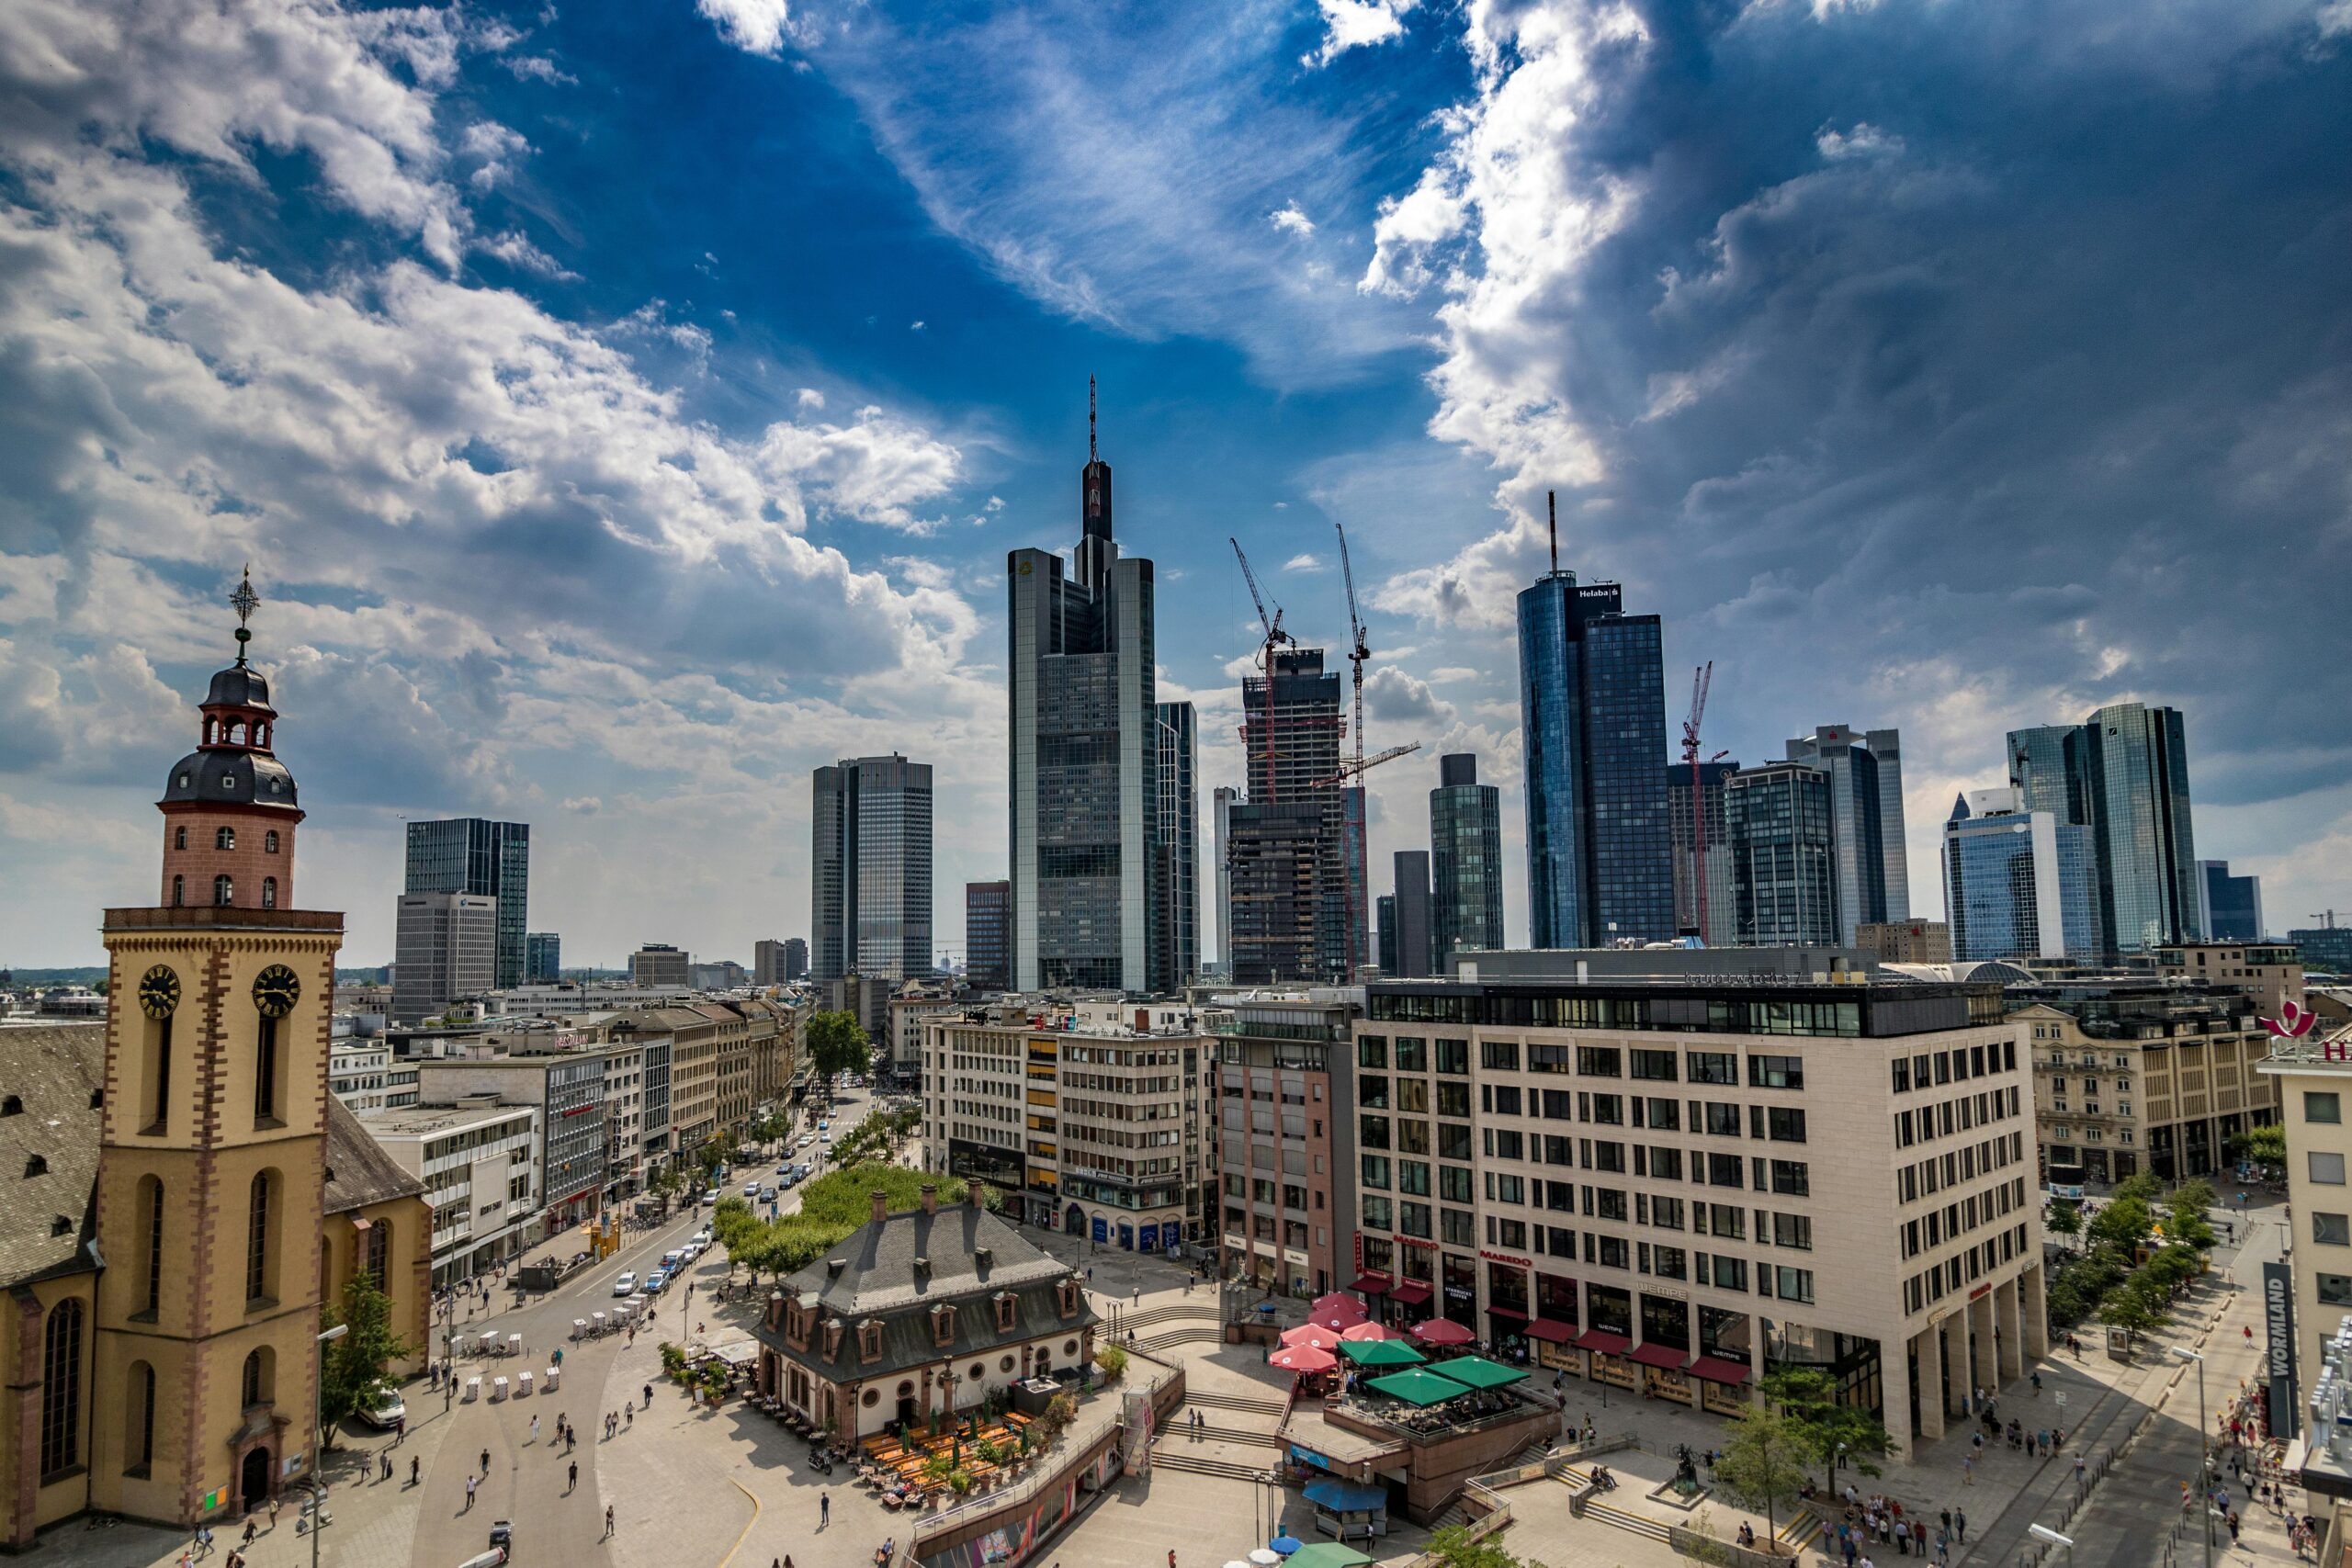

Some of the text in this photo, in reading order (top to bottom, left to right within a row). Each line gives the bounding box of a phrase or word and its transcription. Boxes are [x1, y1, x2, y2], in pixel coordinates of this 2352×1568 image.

[1579, 589, 1608, 598] Helaba
[1685, 972, 1802, 987] hauptwache 7
[1393, 1235, 1440, 1251] MAREDO
[1480, 1250, 1532, 1267] MAREDO
[1445, 1287, 1472, 1297] STARBUCKS
[1636, 1282, 1688, 1300] WEMPE
[1599, 1323, 1623, 1334] WEMPE
[2268, 1278, 2289, 1376] WORMLAND
[1712, 1349, 1740, 1360] WEMPE
